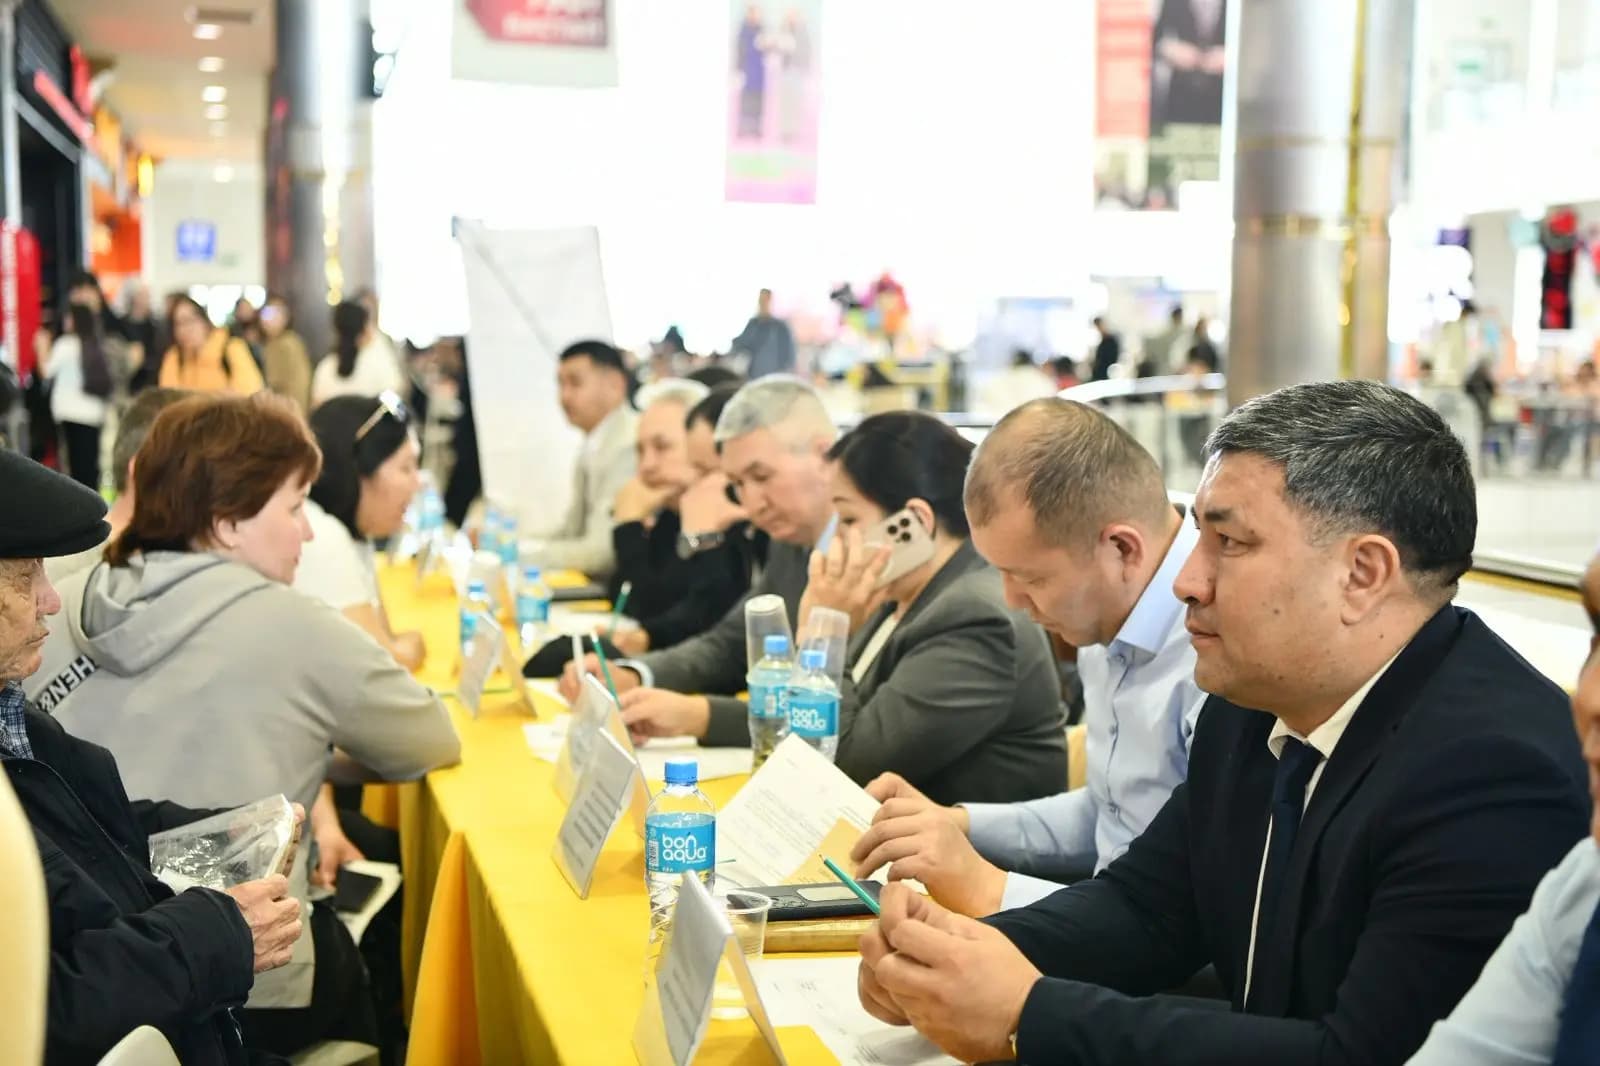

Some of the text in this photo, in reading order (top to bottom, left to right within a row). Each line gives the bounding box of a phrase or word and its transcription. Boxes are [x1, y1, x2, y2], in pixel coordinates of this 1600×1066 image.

[36, 655, 95, 713] HEN&
[792, 718, 827, 731] aqua
[662, 848, 707, 863] aqua
